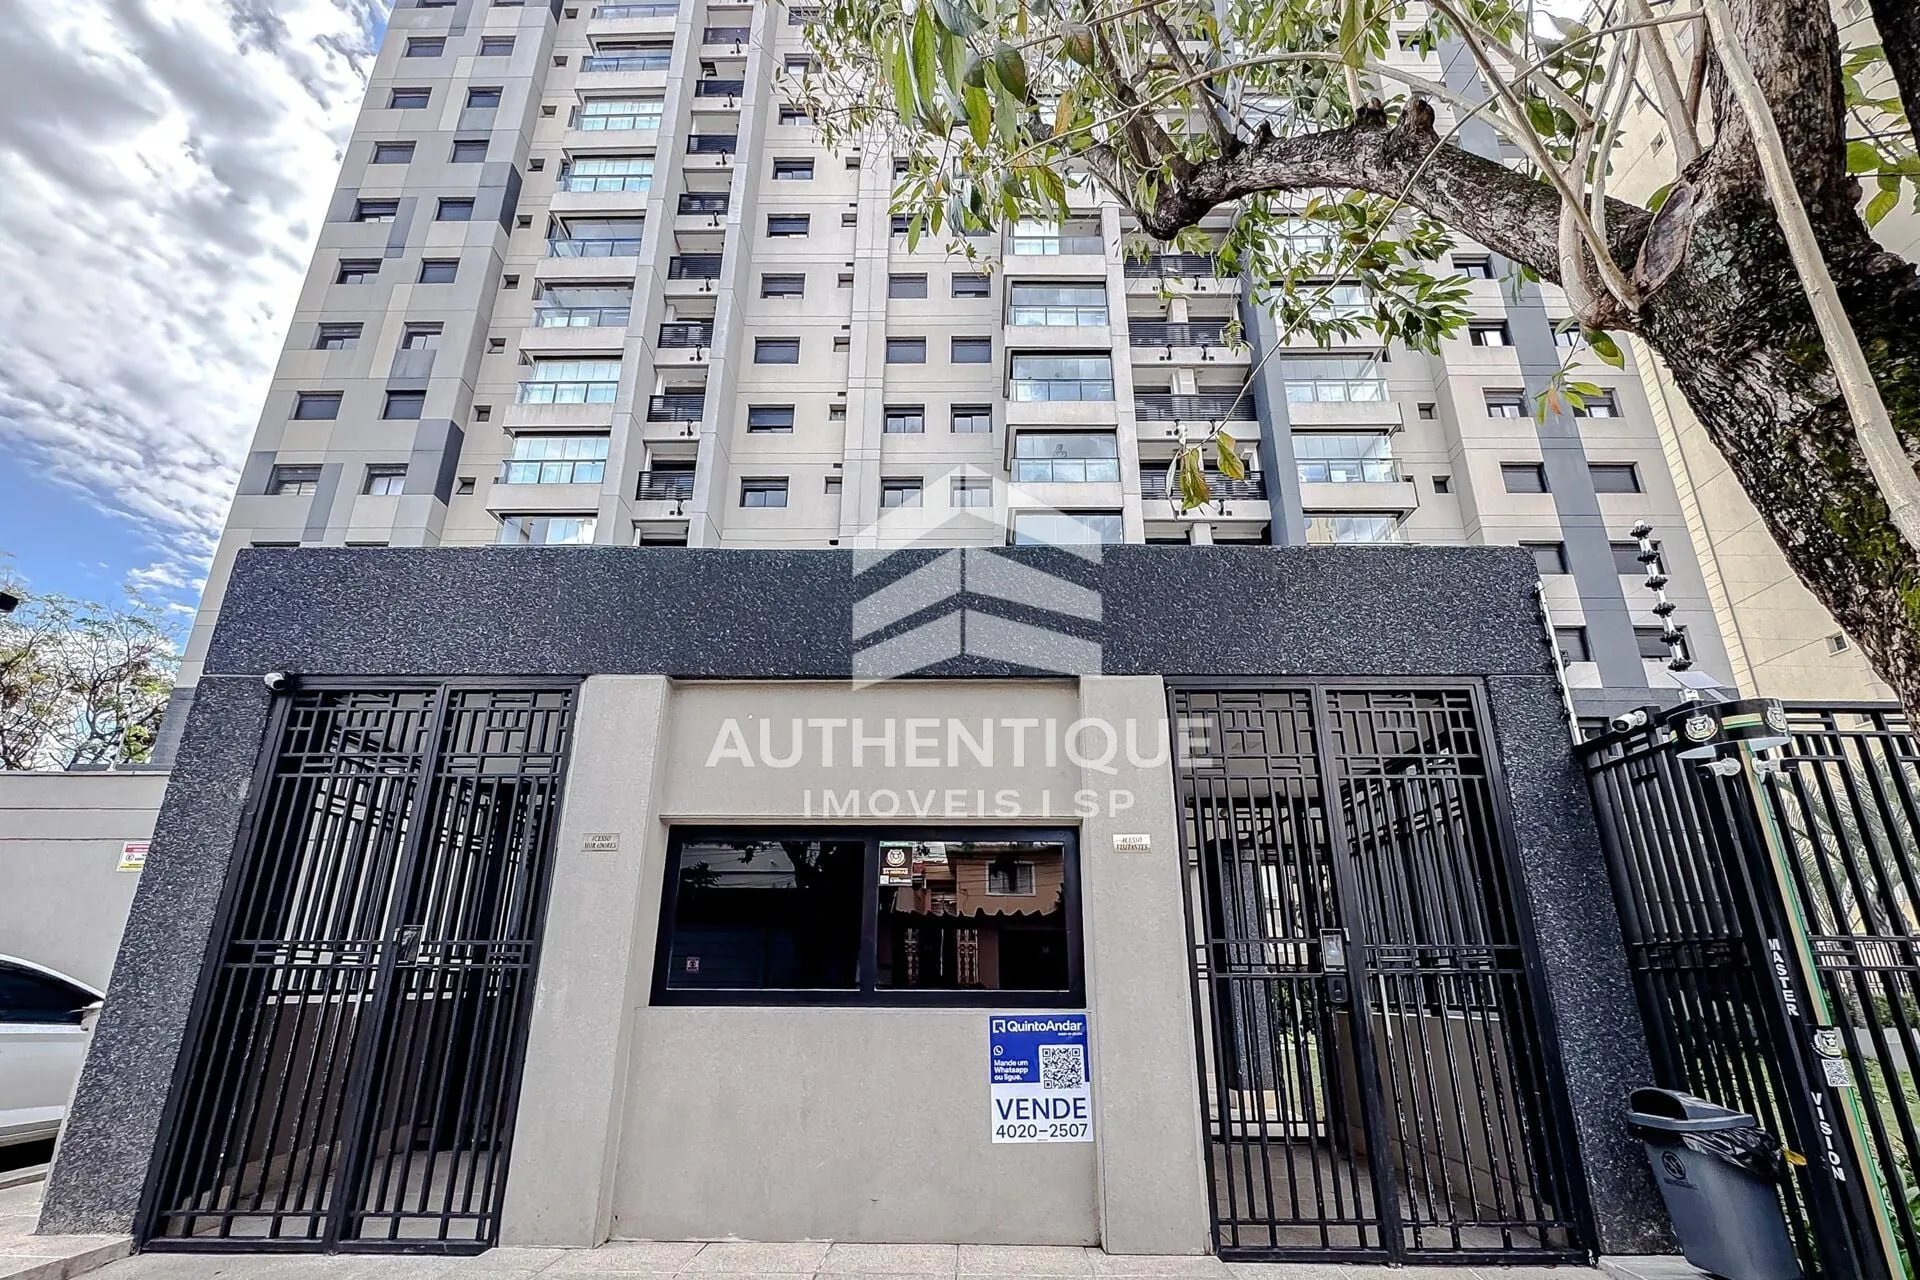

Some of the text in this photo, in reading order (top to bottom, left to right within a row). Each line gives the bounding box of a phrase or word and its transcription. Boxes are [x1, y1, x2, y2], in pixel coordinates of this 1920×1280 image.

[1007, 1020, 1083, 1032] QuintoAndar
[1767, 938, 1846, 1182] MASTER VISION
[995, 1097, 1088, 1120] VENDE
[995, 1123, 1088, 1138] 4020-2507
